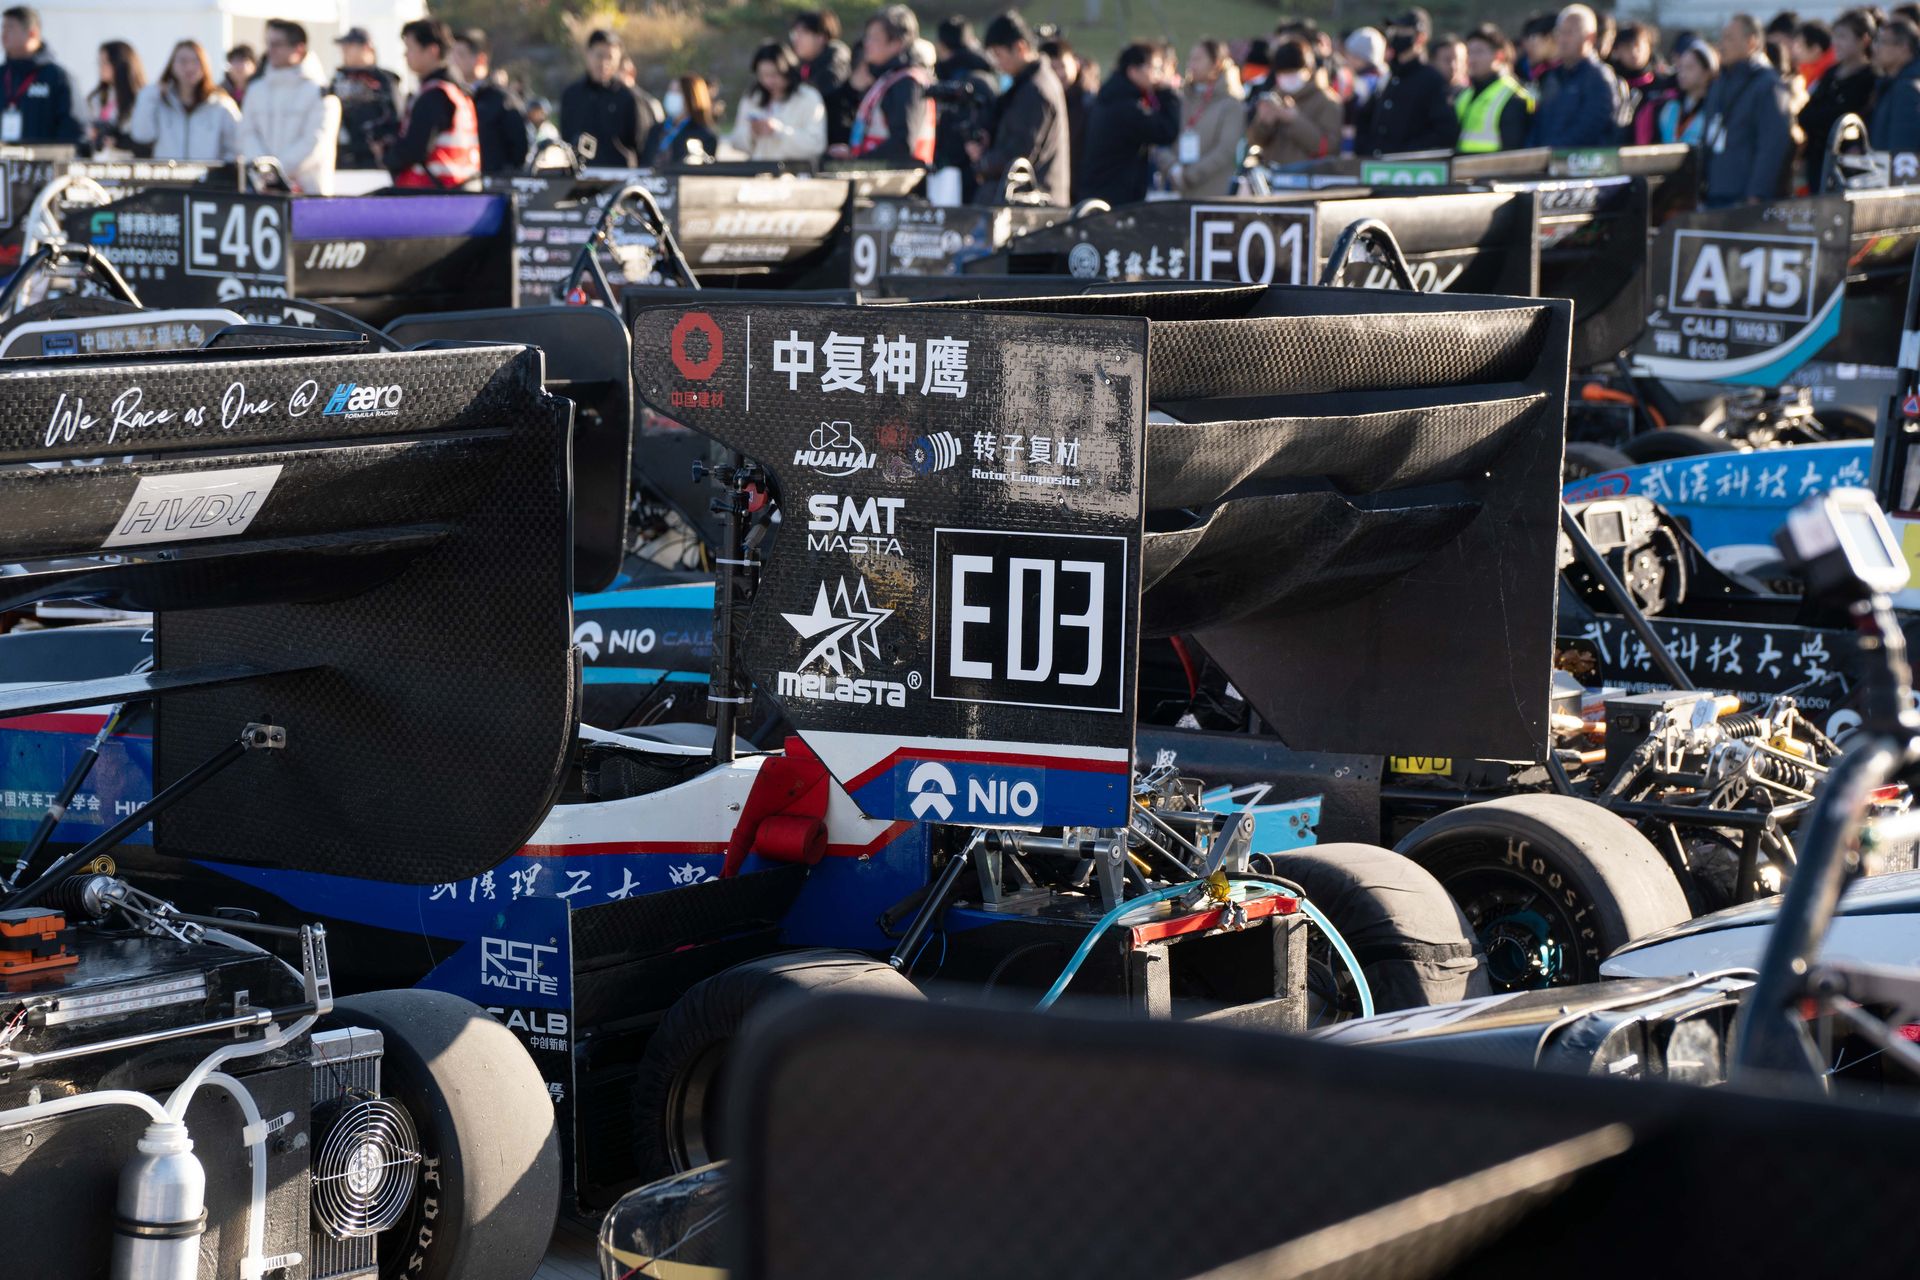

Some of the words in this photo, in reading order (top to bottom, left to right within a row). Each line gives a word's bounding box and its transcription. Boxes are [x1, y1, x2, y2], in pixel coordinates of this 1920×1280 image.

[191, 201, 282, 271] E46
[80, 324, 203, 351] 中国汽车工程学会
[773, 330, 970, 399] 中复神鹰
[45, 393, 100, 447] We
[108, 387, 178, 444] Race
[184, 405, 206, 427] as
[221, 381, 277, 429] One
[344, 412, 375, 421] FORMULA
[375, 409, 399, 418] RACING
[670, 390, 725, 409] 中国建材
[793, 449, 877, 470] HUAHAI
[973, 430, 1081, 468] 转子复材
[971, 467, 1008, 482] Rotor
[1010, 470, 1081, 487] Composite
[119, 493, 234, 536] HVD
[808, 494, 905, 535] SMT
[807, 533, 904, 557] MASTA
[949, 554, 1105, 687] E03
[608, 627, 656, 655] NIO
[968, 778, 1038, 817] NIO
[1502, 835, 1600, 961] Hoosier
[481, 936, 558, 982] RSC
[481, 972, 558, 996] WUTE
[530, 1035, 568, 1052] 中创新航
